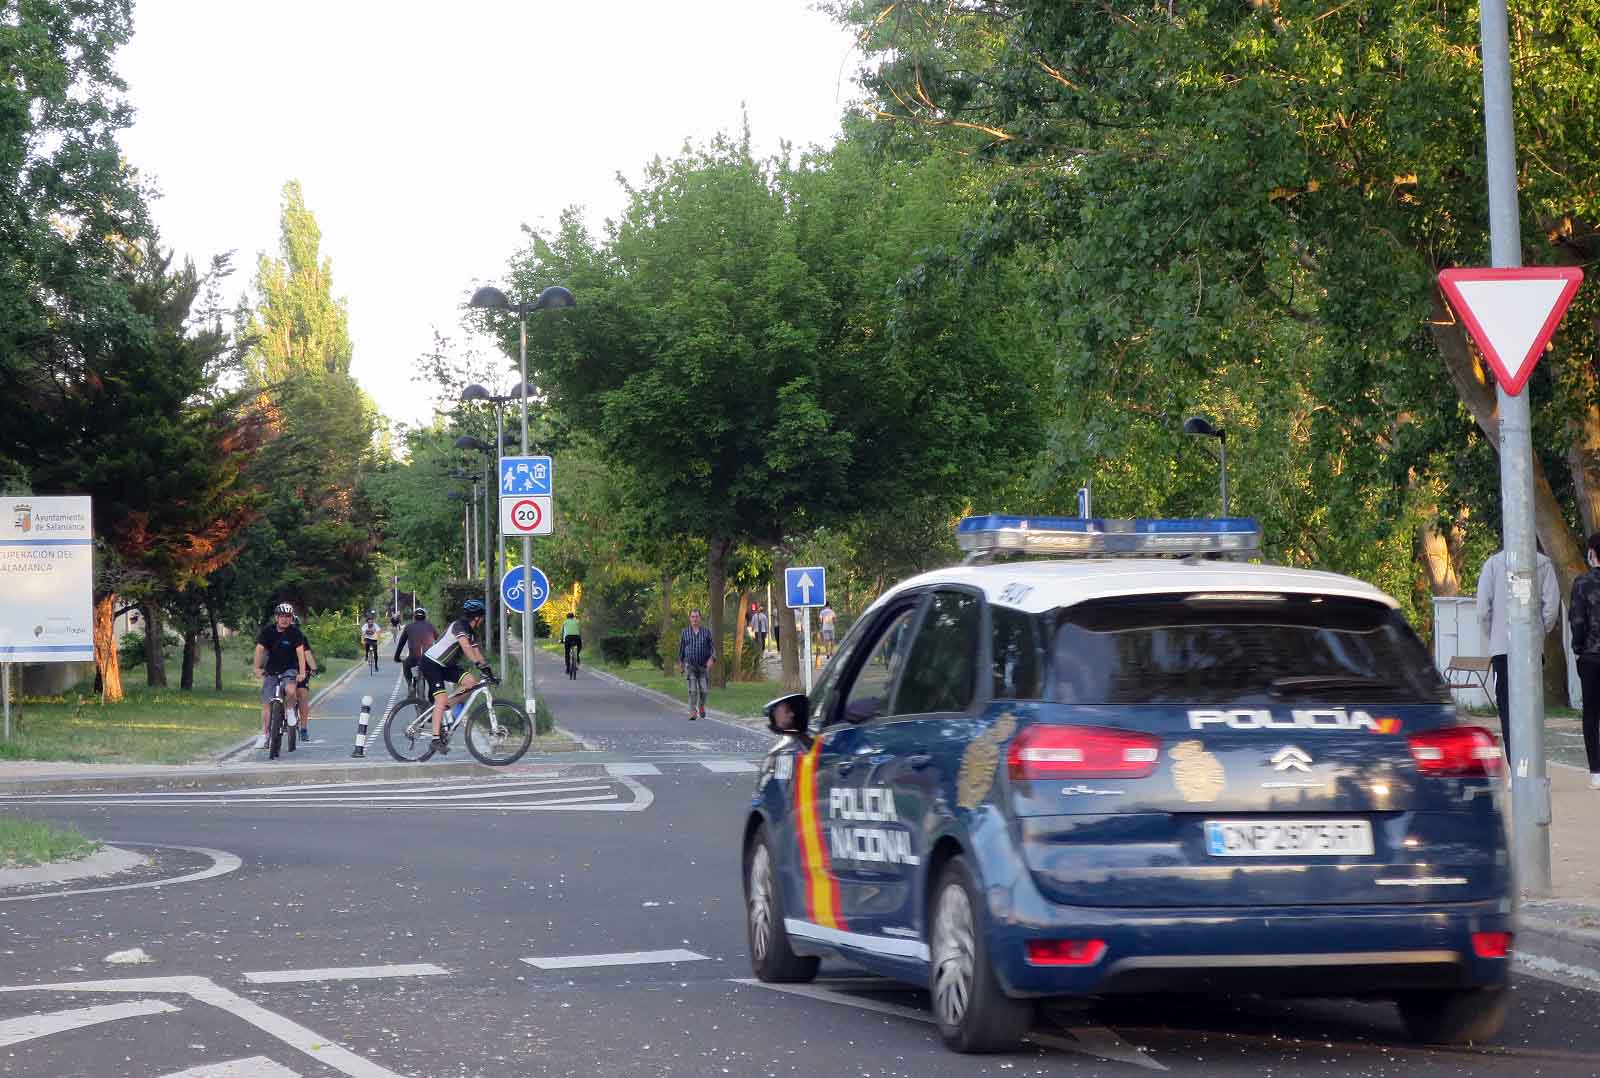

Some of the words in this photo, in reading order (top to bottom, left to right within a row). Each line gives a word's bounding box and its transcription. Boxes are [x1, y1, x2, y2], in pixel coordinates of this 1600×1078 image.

[34, 513, 85, 523] Ayuntamiento
[518, 510, 535, 521] 20
[35, 522, 44, 530] de
[46, 522, 85, 531] Salamanca
[831, 824, 921, 865] NACIONAL
